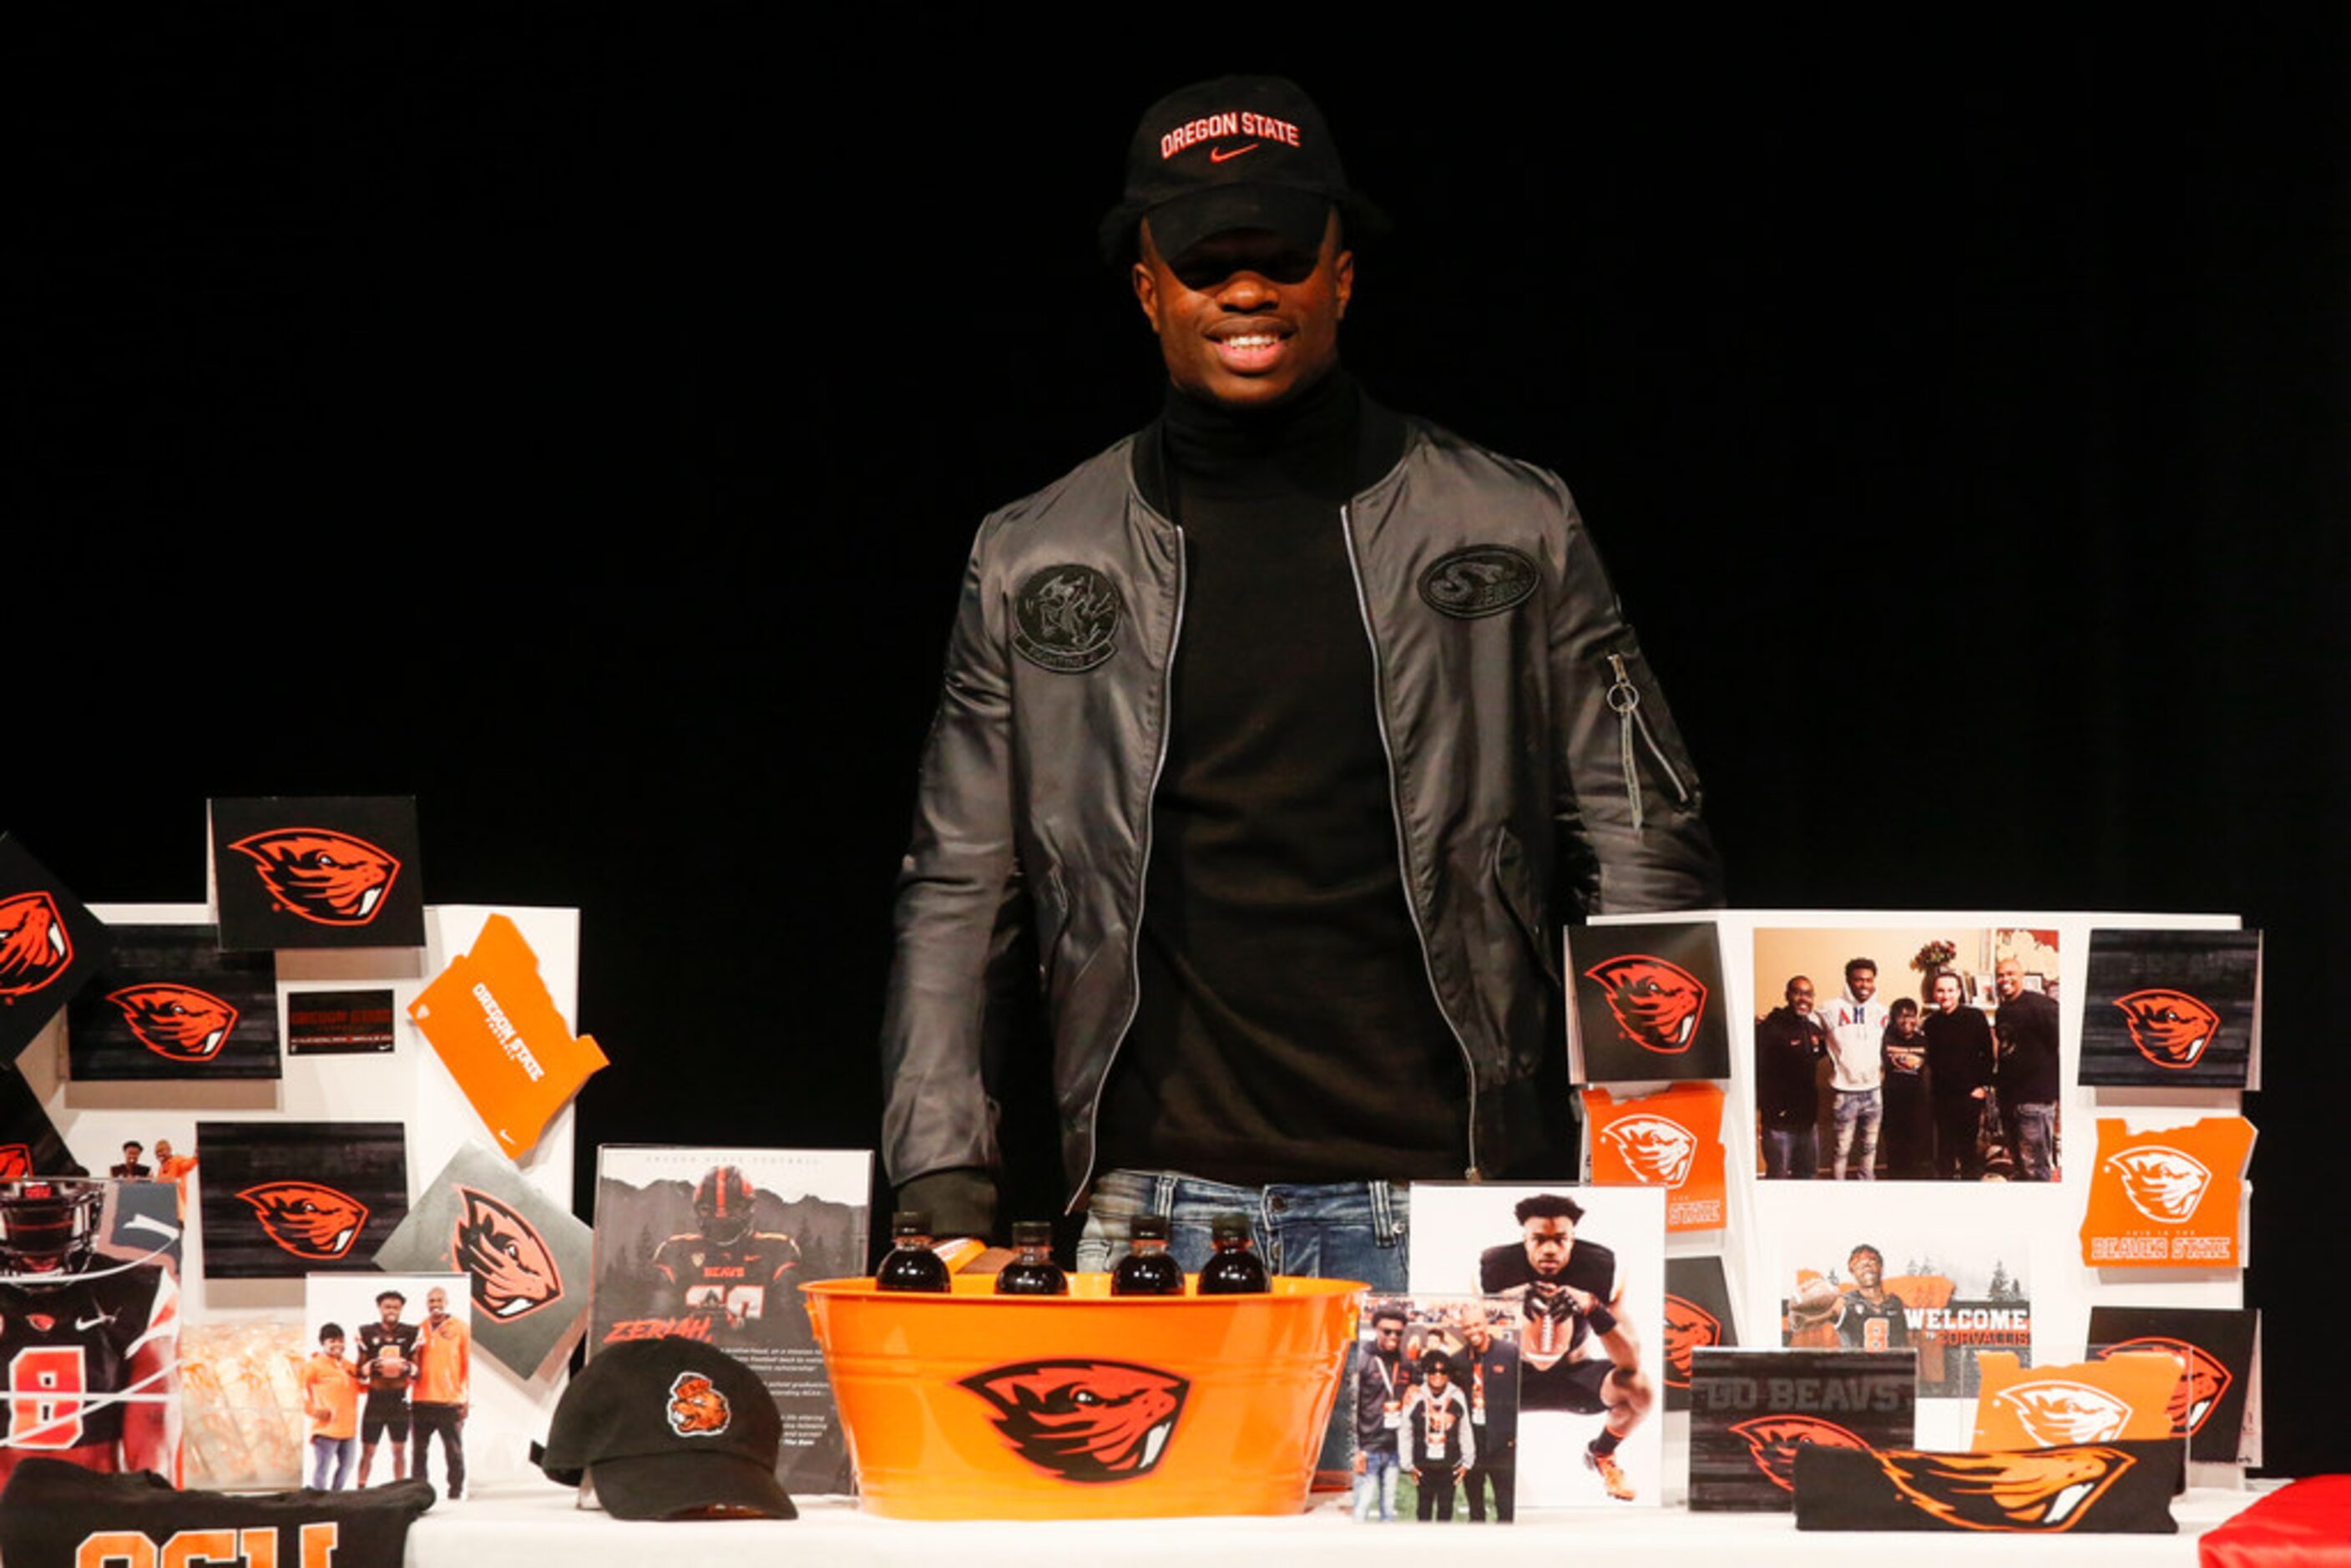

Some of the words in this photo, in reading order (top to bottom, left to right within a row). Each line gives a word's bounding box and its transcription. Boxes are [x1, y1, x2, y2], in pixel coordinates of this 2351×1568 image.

[1160, 112, 1238, 159] OREGON
[1241, 112, 1300, 148] STATE
[472, 982, 517, 1040] OREGON
[509, 1037, 544, 1082] STATE
[2091, 1237, 2168, 1259] BEAVER
[2172, 1237, 2231, 1259] STATE
[704, 1267, 746, 1277] BEAVS
[1863, 1318, 1889, 1352] 8
[1903, 1308, 2028, 1331] WELCOME
[1707, 1378, 1757, 1409] GO
[1768, 1378, 1899, 1411] BEAVS
